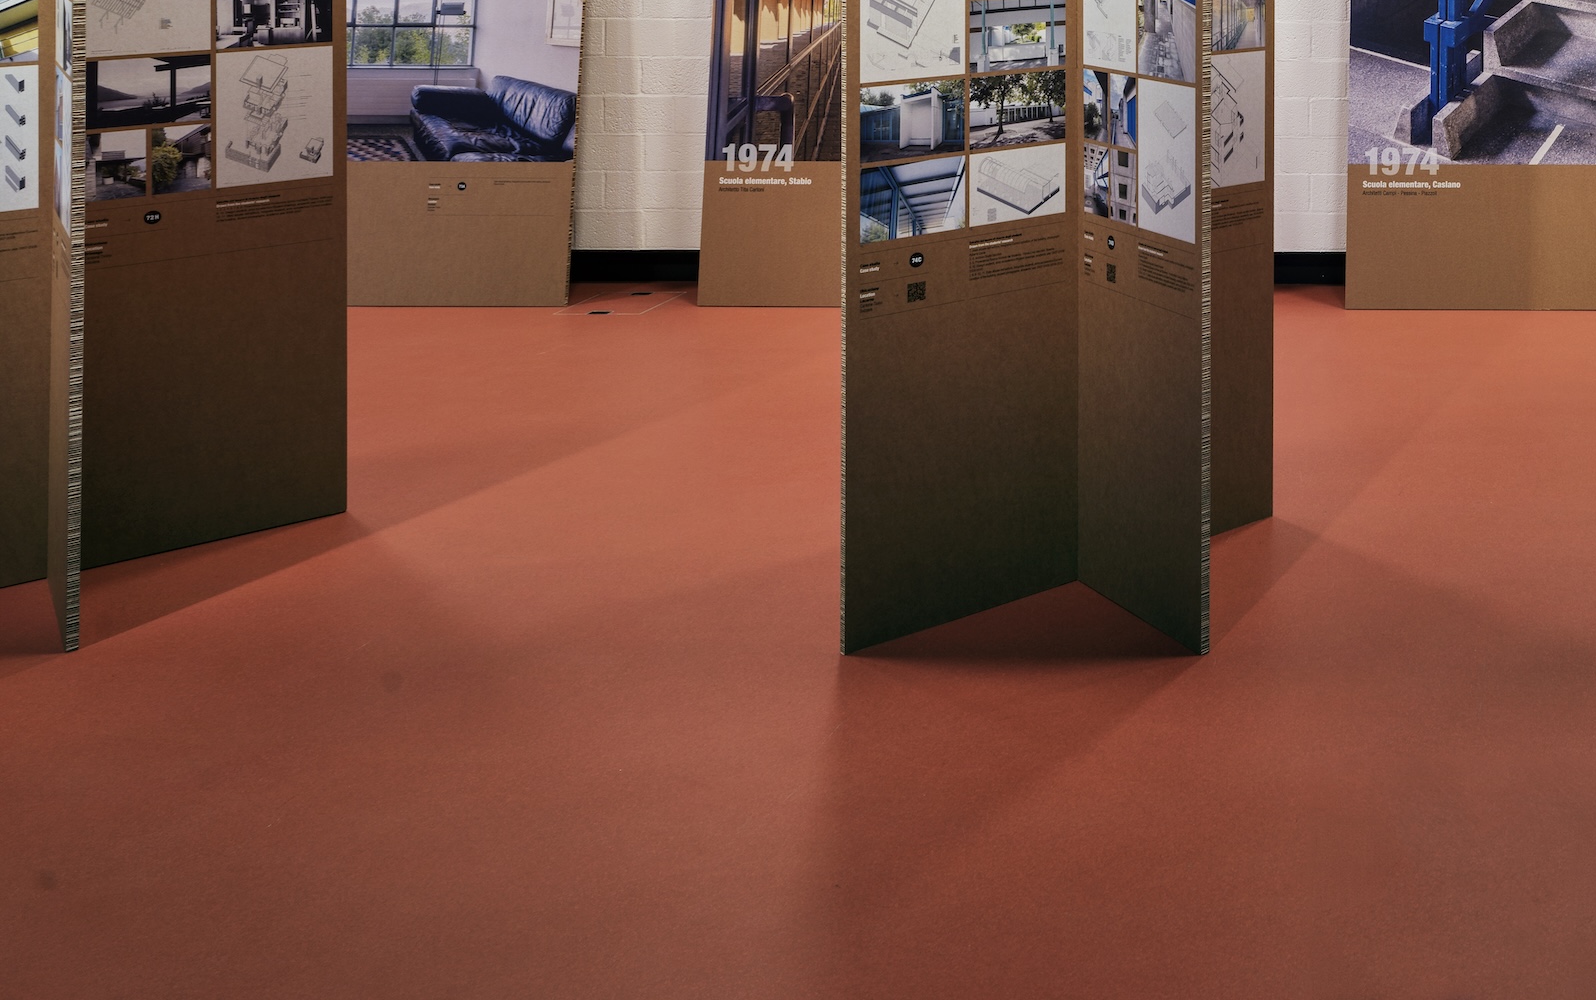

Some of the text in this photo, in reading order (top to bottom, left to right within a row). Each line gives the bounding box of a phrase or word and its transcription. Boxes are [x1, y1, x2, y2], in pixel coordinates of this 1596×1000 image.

[722, 143, 794, 172] 1974
[1365, 146, 1440, 176] 1974
[719, 177, 812, 187] Scuola elementare, Stabio
[1362, 180, 1461, 190] Scuola elementare, Caslano
